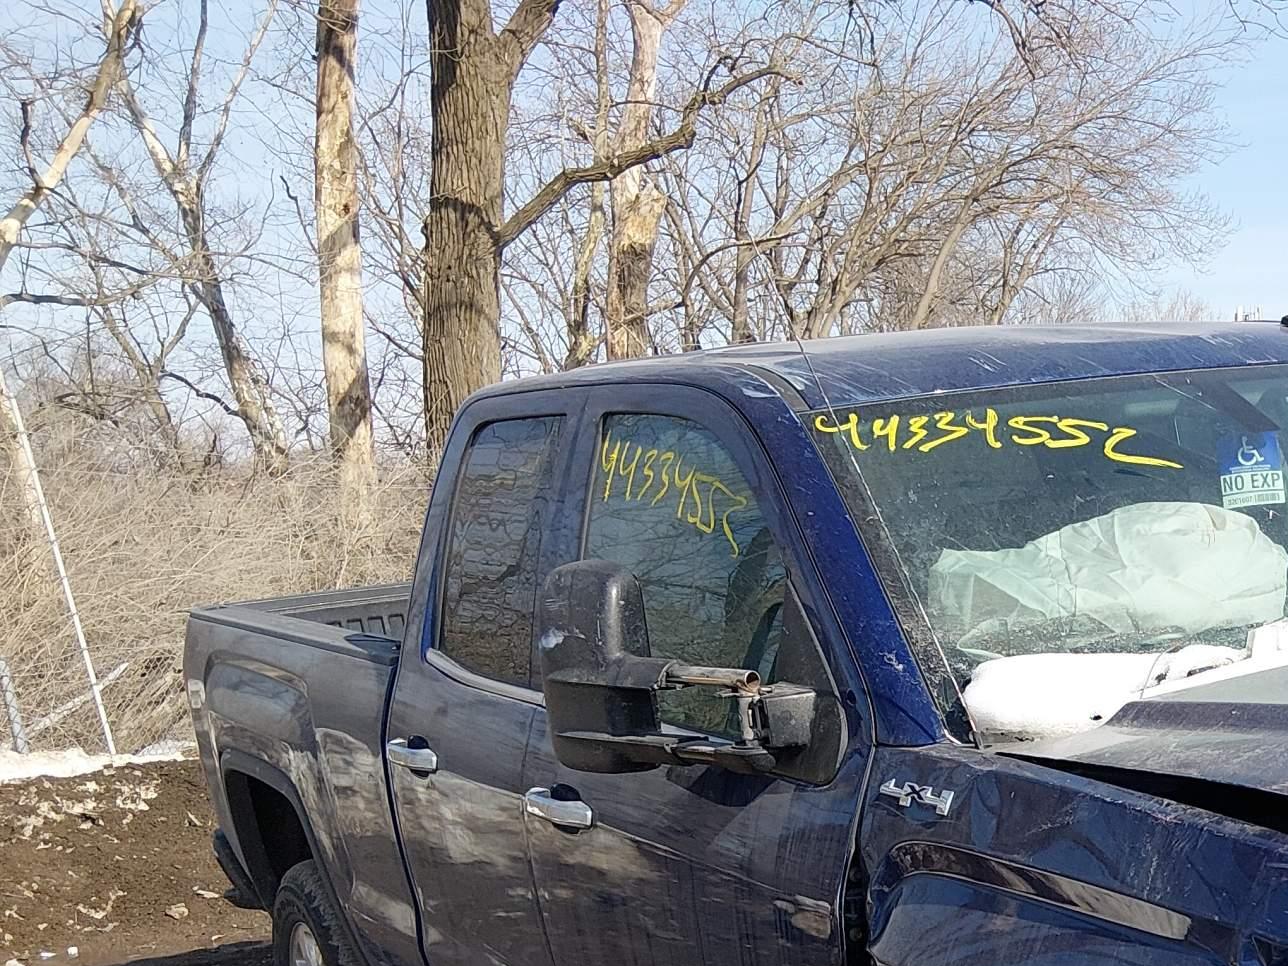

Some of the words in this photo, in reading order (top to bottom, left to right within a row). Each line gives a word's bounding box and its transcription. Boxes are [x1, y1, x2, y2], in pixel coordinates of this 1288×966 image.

[814, 408, 1184, 469] 44334552
[602, 430, 747, 559] 44334552
[1222, 475, 1244, 493] NO
[1251, 473, 1280, 488] EXP
